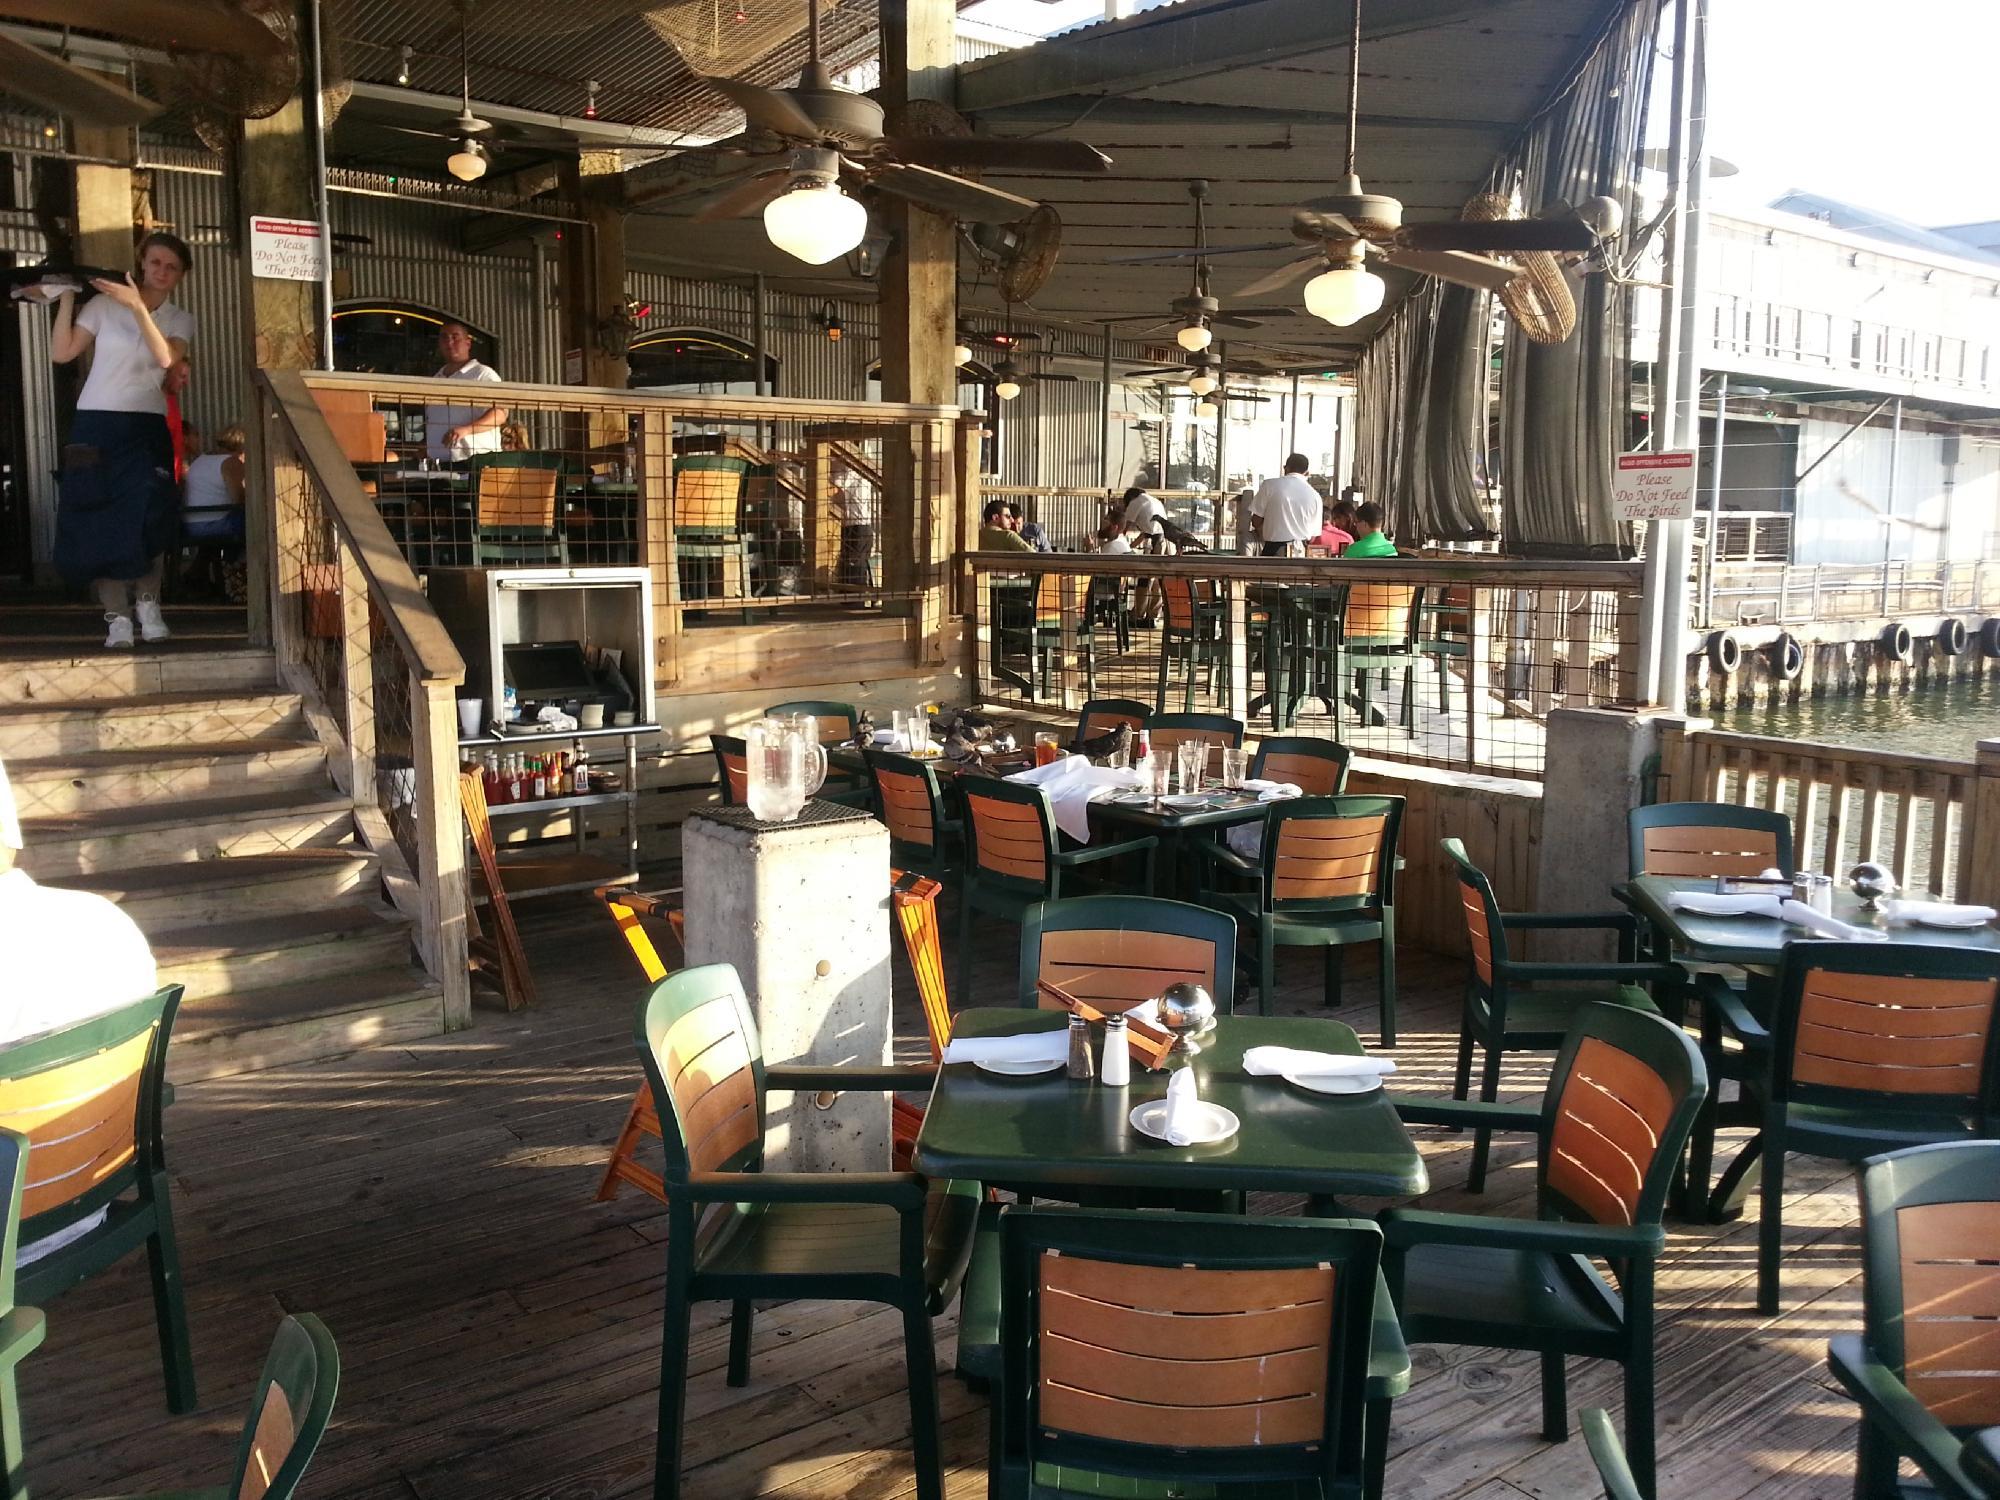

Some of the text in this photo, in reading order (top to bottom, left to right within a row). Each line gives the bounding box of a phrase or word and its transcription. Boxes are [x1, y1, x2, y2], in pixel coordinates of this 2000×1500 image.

[274, 237, 309, 249] Please
[255, 250, 273, 261] Do
[276, 251, 297, 264] Not
[265, 264, 320, 278] The Birds
[1637, 473, 1672, 485] Please
[1616, 487, 1691, 503] Do Not Feed
[1625, 502, 1680, 516] The Birds
